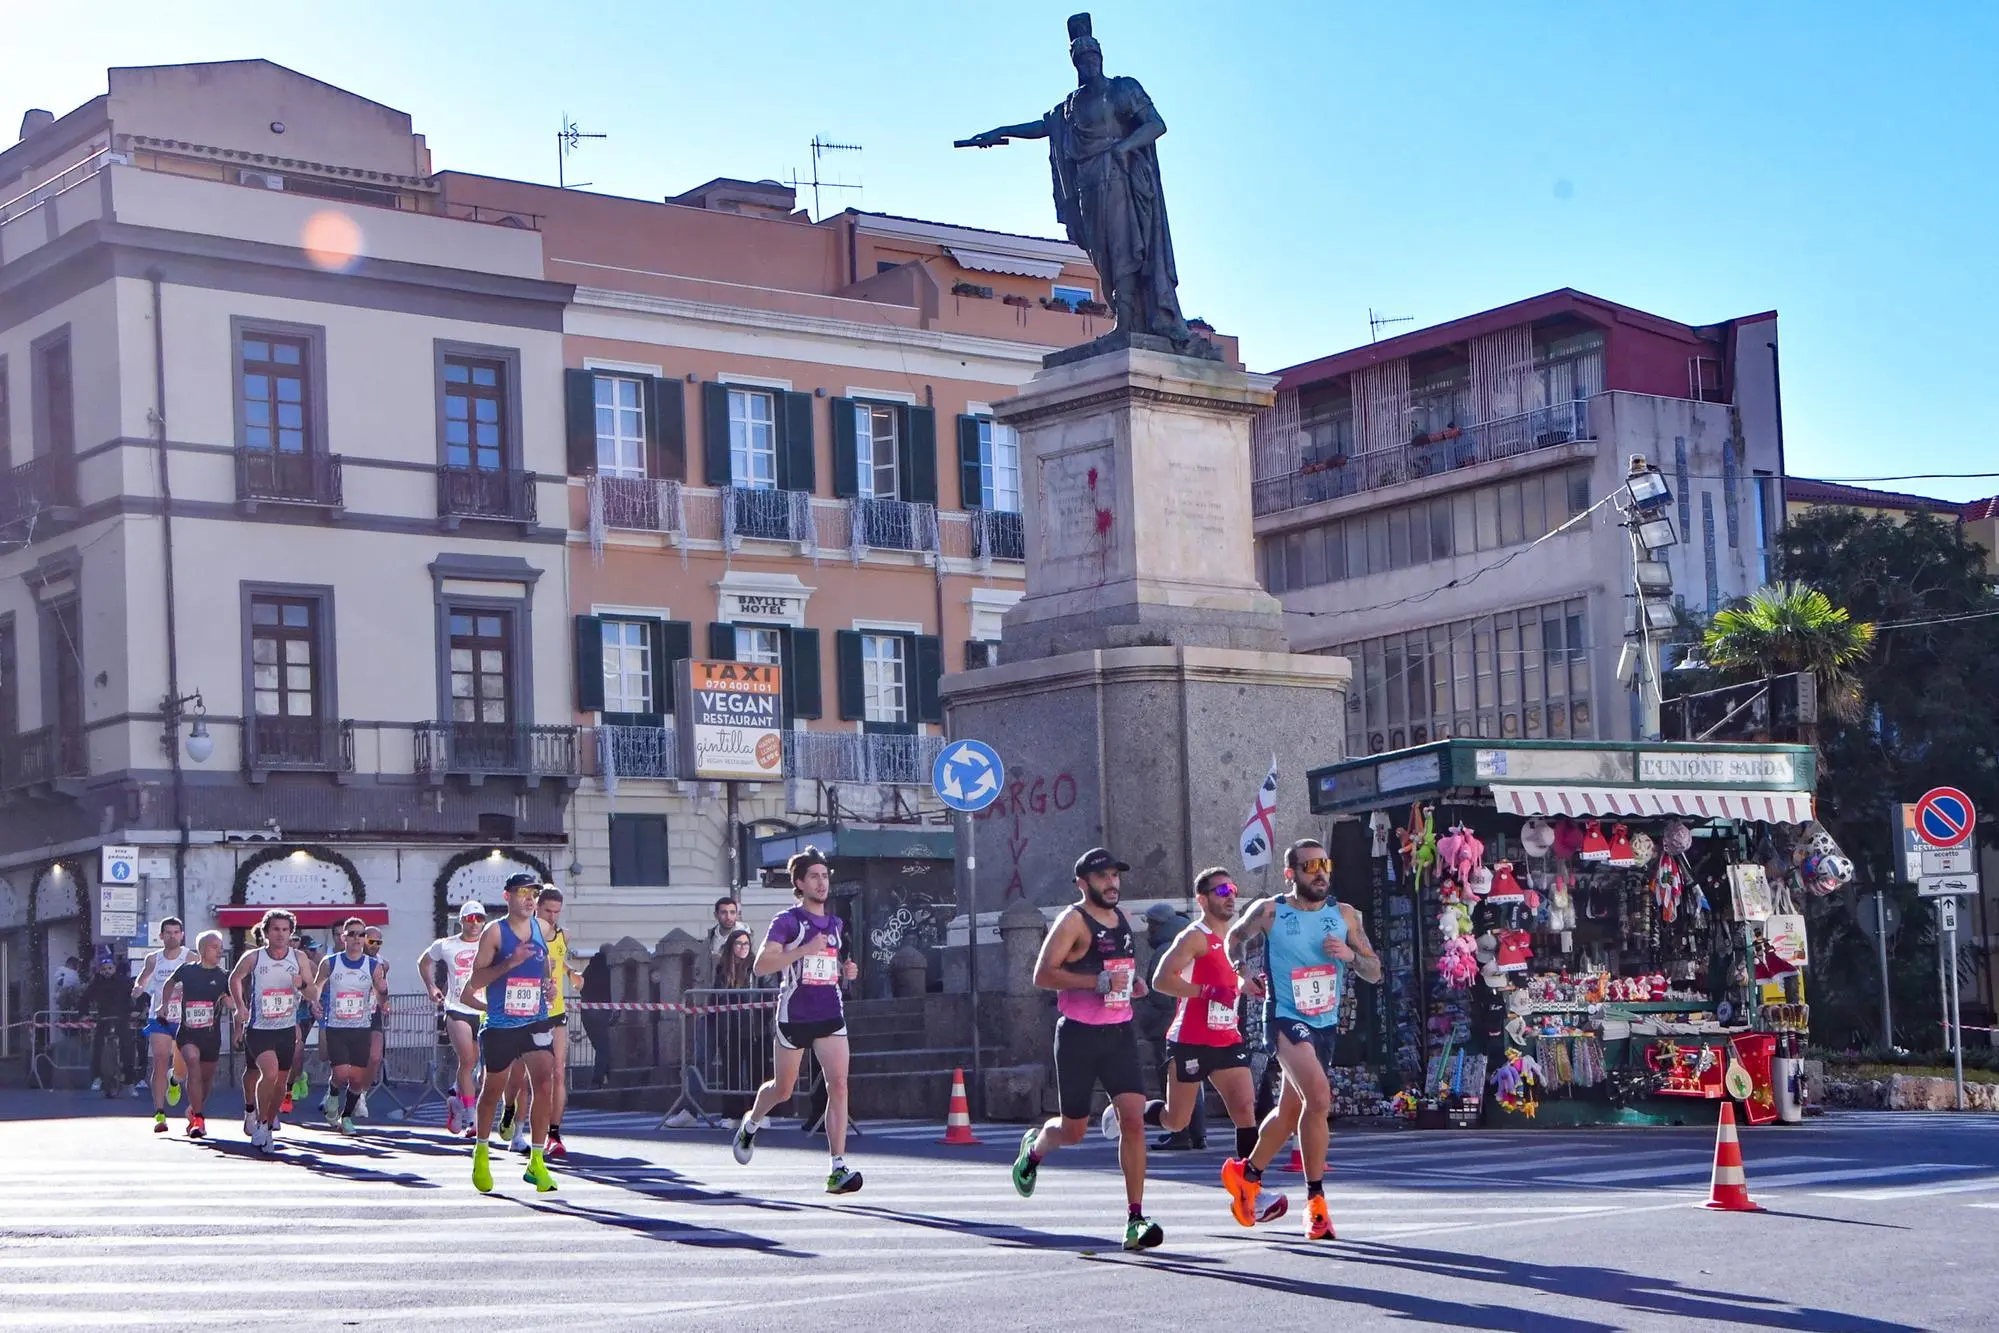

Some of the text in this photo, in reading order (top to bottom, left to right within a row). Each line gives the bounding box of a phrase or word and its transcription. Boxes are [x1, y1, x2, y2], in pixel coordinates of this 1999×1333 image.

[740, 605, 785, 615] HOTEL
[700, 664, 771, 682] TAXI
[706, 680, 772, 693] 070 400 101
[700, 692, 774, 714] VEGAN
[703, 712, 774, 727] RESTAURANT
[1644, 759, 1786, 776] L'UNIONE SARDA
[816, 958, 825, 969] 21
[1312, 980, 1320, 994] 9
[517, 989, 532, 1000] 830
[346, 999, 354, 1007] 13
